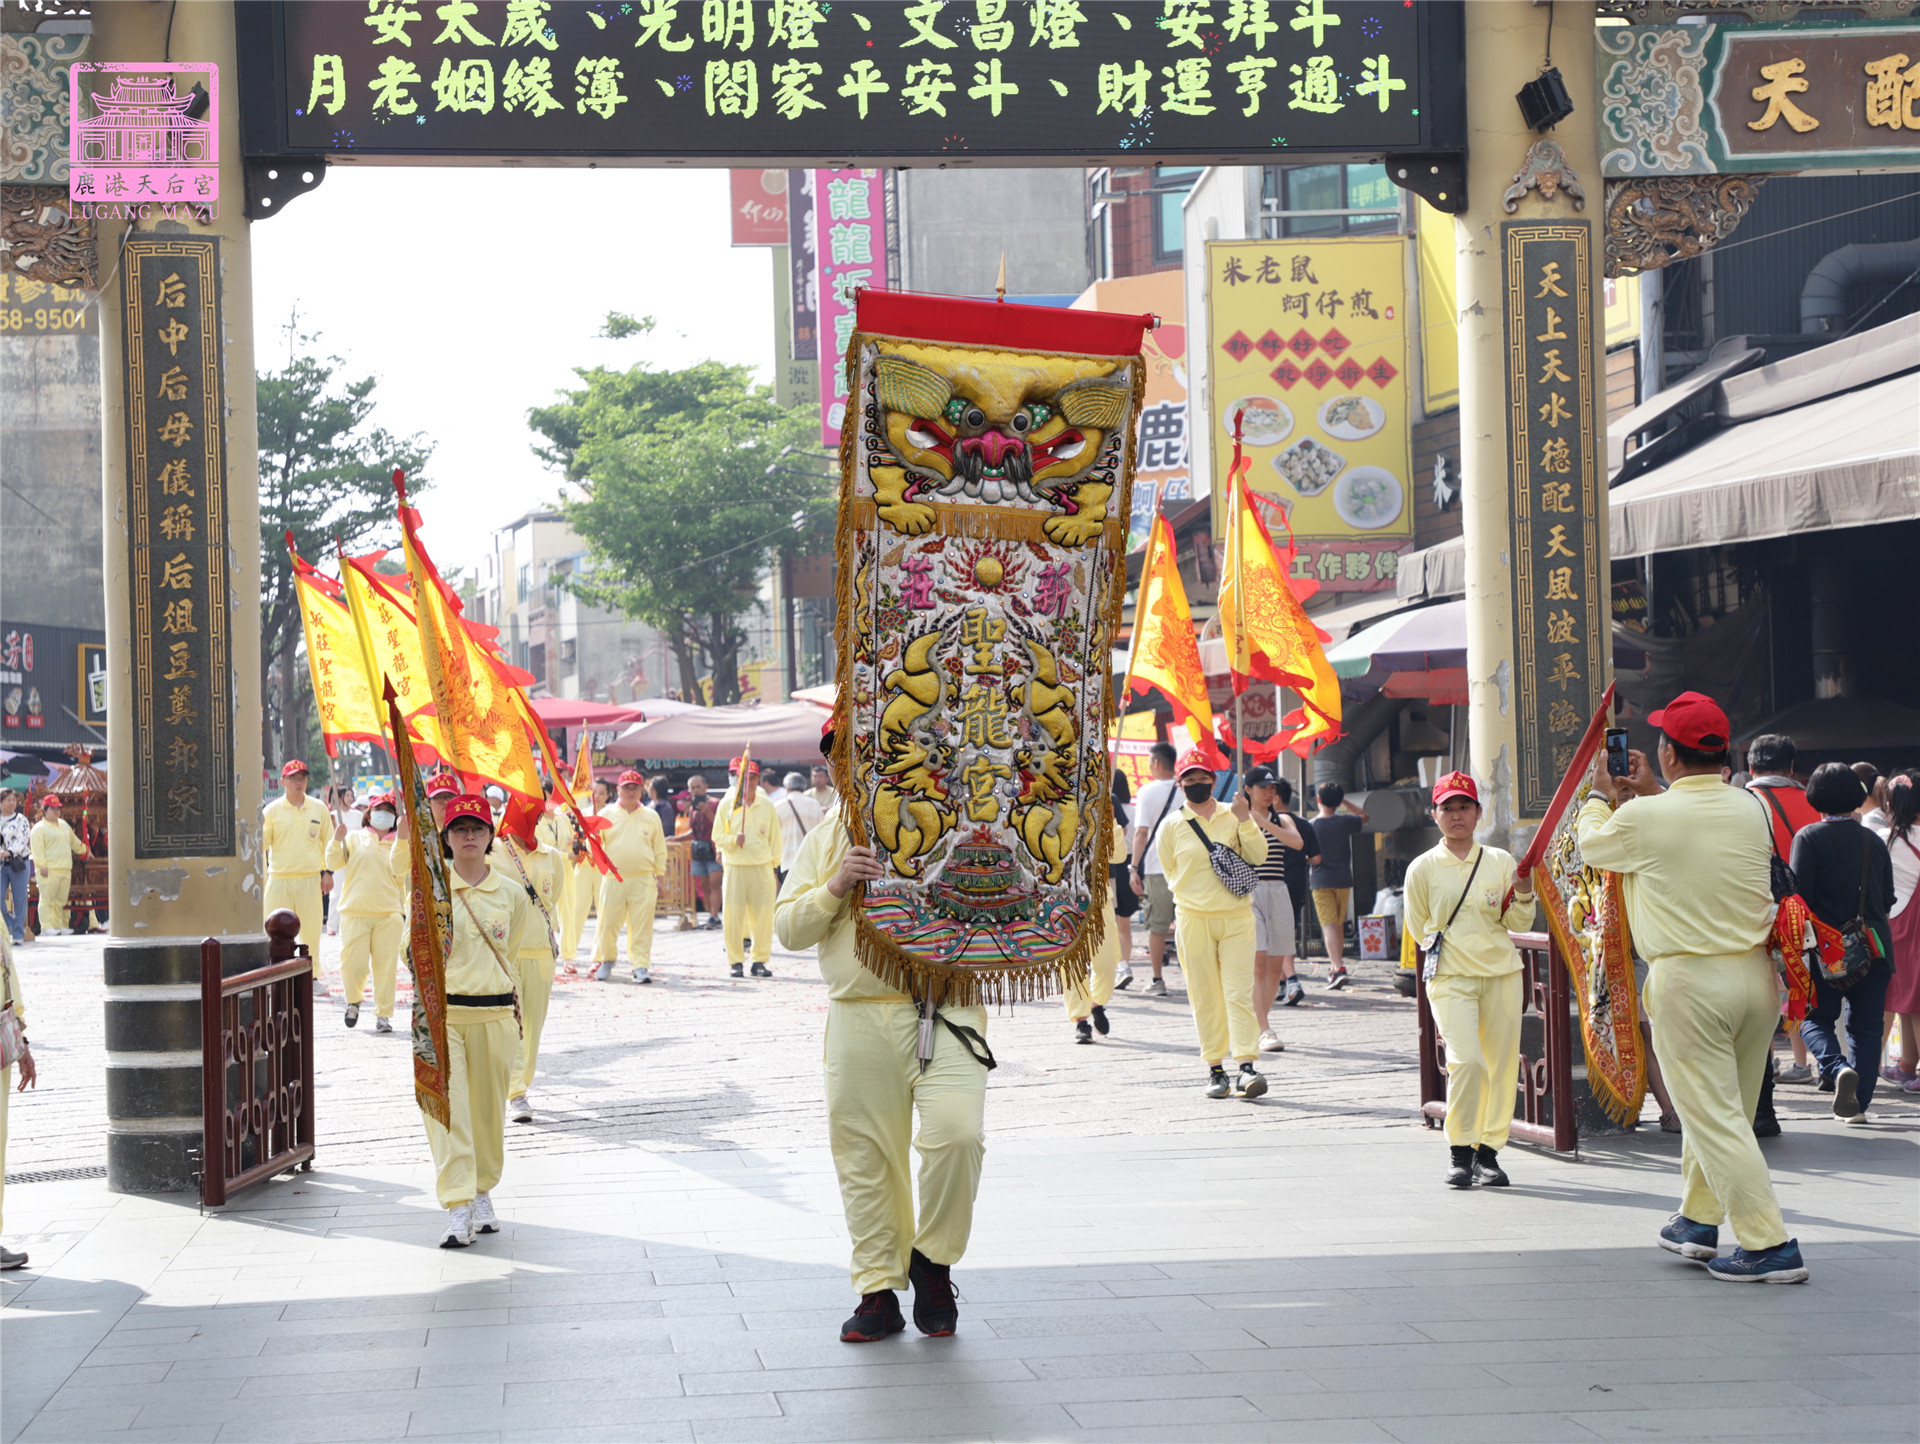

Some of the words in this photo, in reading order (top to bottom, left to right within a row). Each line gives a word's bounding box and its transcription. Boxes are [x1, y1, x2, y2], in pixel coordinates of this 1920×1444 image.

[306, 54, 1407, 119] 月老姻緣簿、閤家平安斗、財運亨通斗
[1223, 255, 1319, 287] 米老鼠
[1282, 288, 1380, 320] 蚵仔煎
[1288, 551, 1399, 582] 工作夥伴
[0, 630, 22, 671] 芳
[309, 610, 337, 721] 新莊聖龍宮
[958, 606, 1014, 824] 聖龍宮
